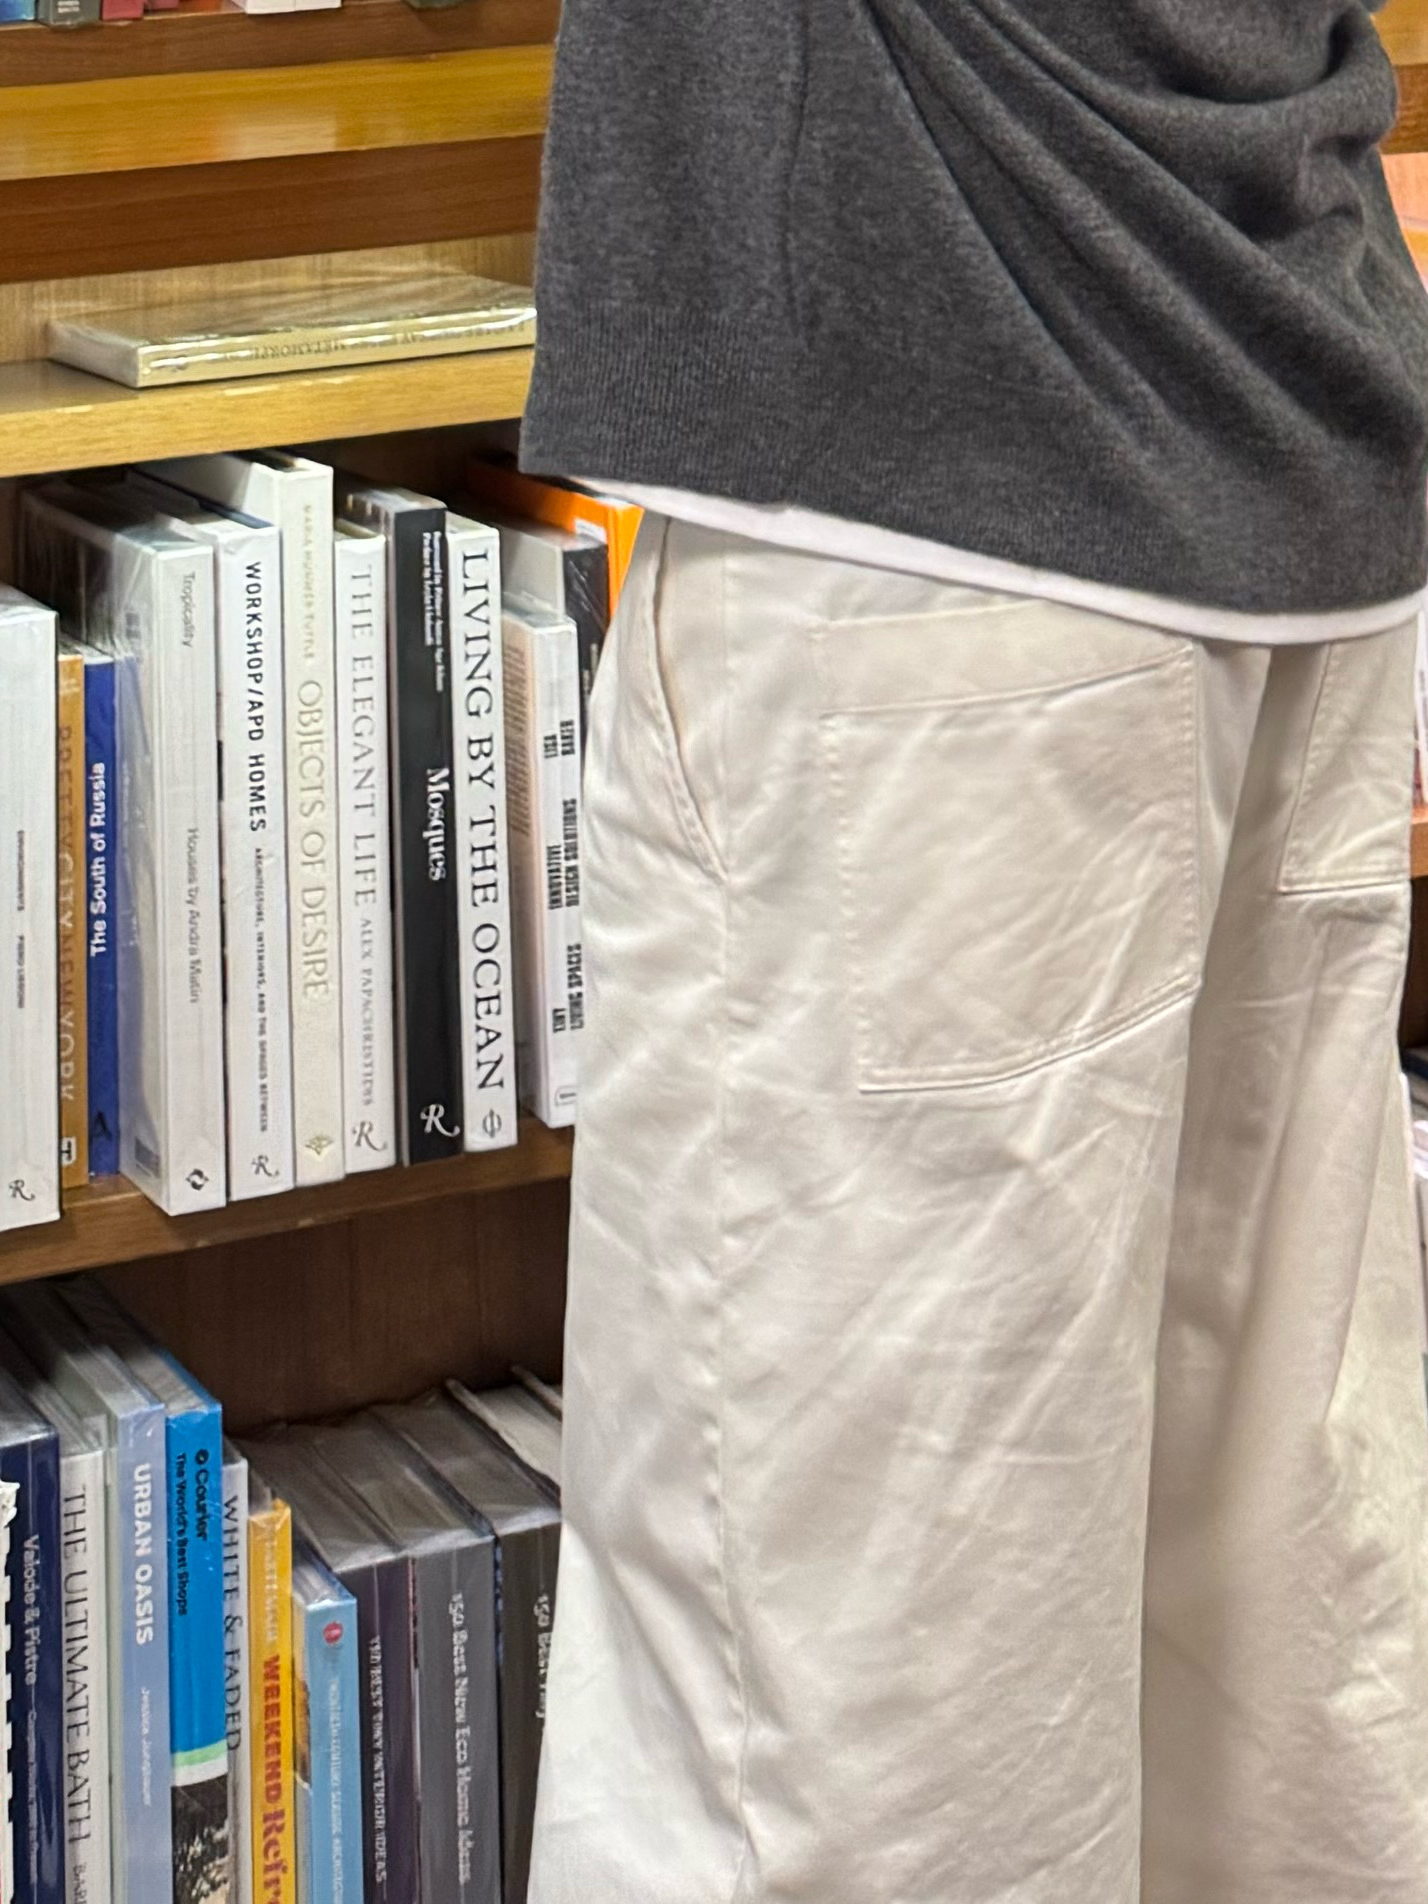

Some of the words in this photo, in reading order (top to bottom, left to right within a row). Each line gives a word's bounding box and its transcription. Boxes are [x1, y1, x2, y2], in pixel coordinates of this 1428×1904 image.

[350, 564, 375, 638] THE
[461, 549, 494, 717] LIVING
[243, 561, 264, 743] WORKSHOP/APD
[297, 678, 327, 821] OBJECTS
[350, 652, 376, 822] ELEGANT
[466, 728, 495, 791] BY
[89, 761, 107, 831] Russia
[244, 751, 266, 832] HOMES
[423, 767, 449, 882] Mosques
[90, 835, 107, 855] of
[298, 829, 328, 868] OF
[351, 833, 379, 906] LIFE
[468, 817, 499, 909] THE
[90, 858, 108, 918] South
[89, 922, 109, 958] The
[299, 884, 331, 1000] DESIRE
[470, 923, 506, 1091] OCEAN
[62, 1492, 88, 1561] THE
[132, 1464, 152, 1559] URBAN
[134, 1565, 153, 1645] OASIS
[62, 1570, 90, 1749] ULTIMATE
[65, 1754, 92, 1844] BATH
